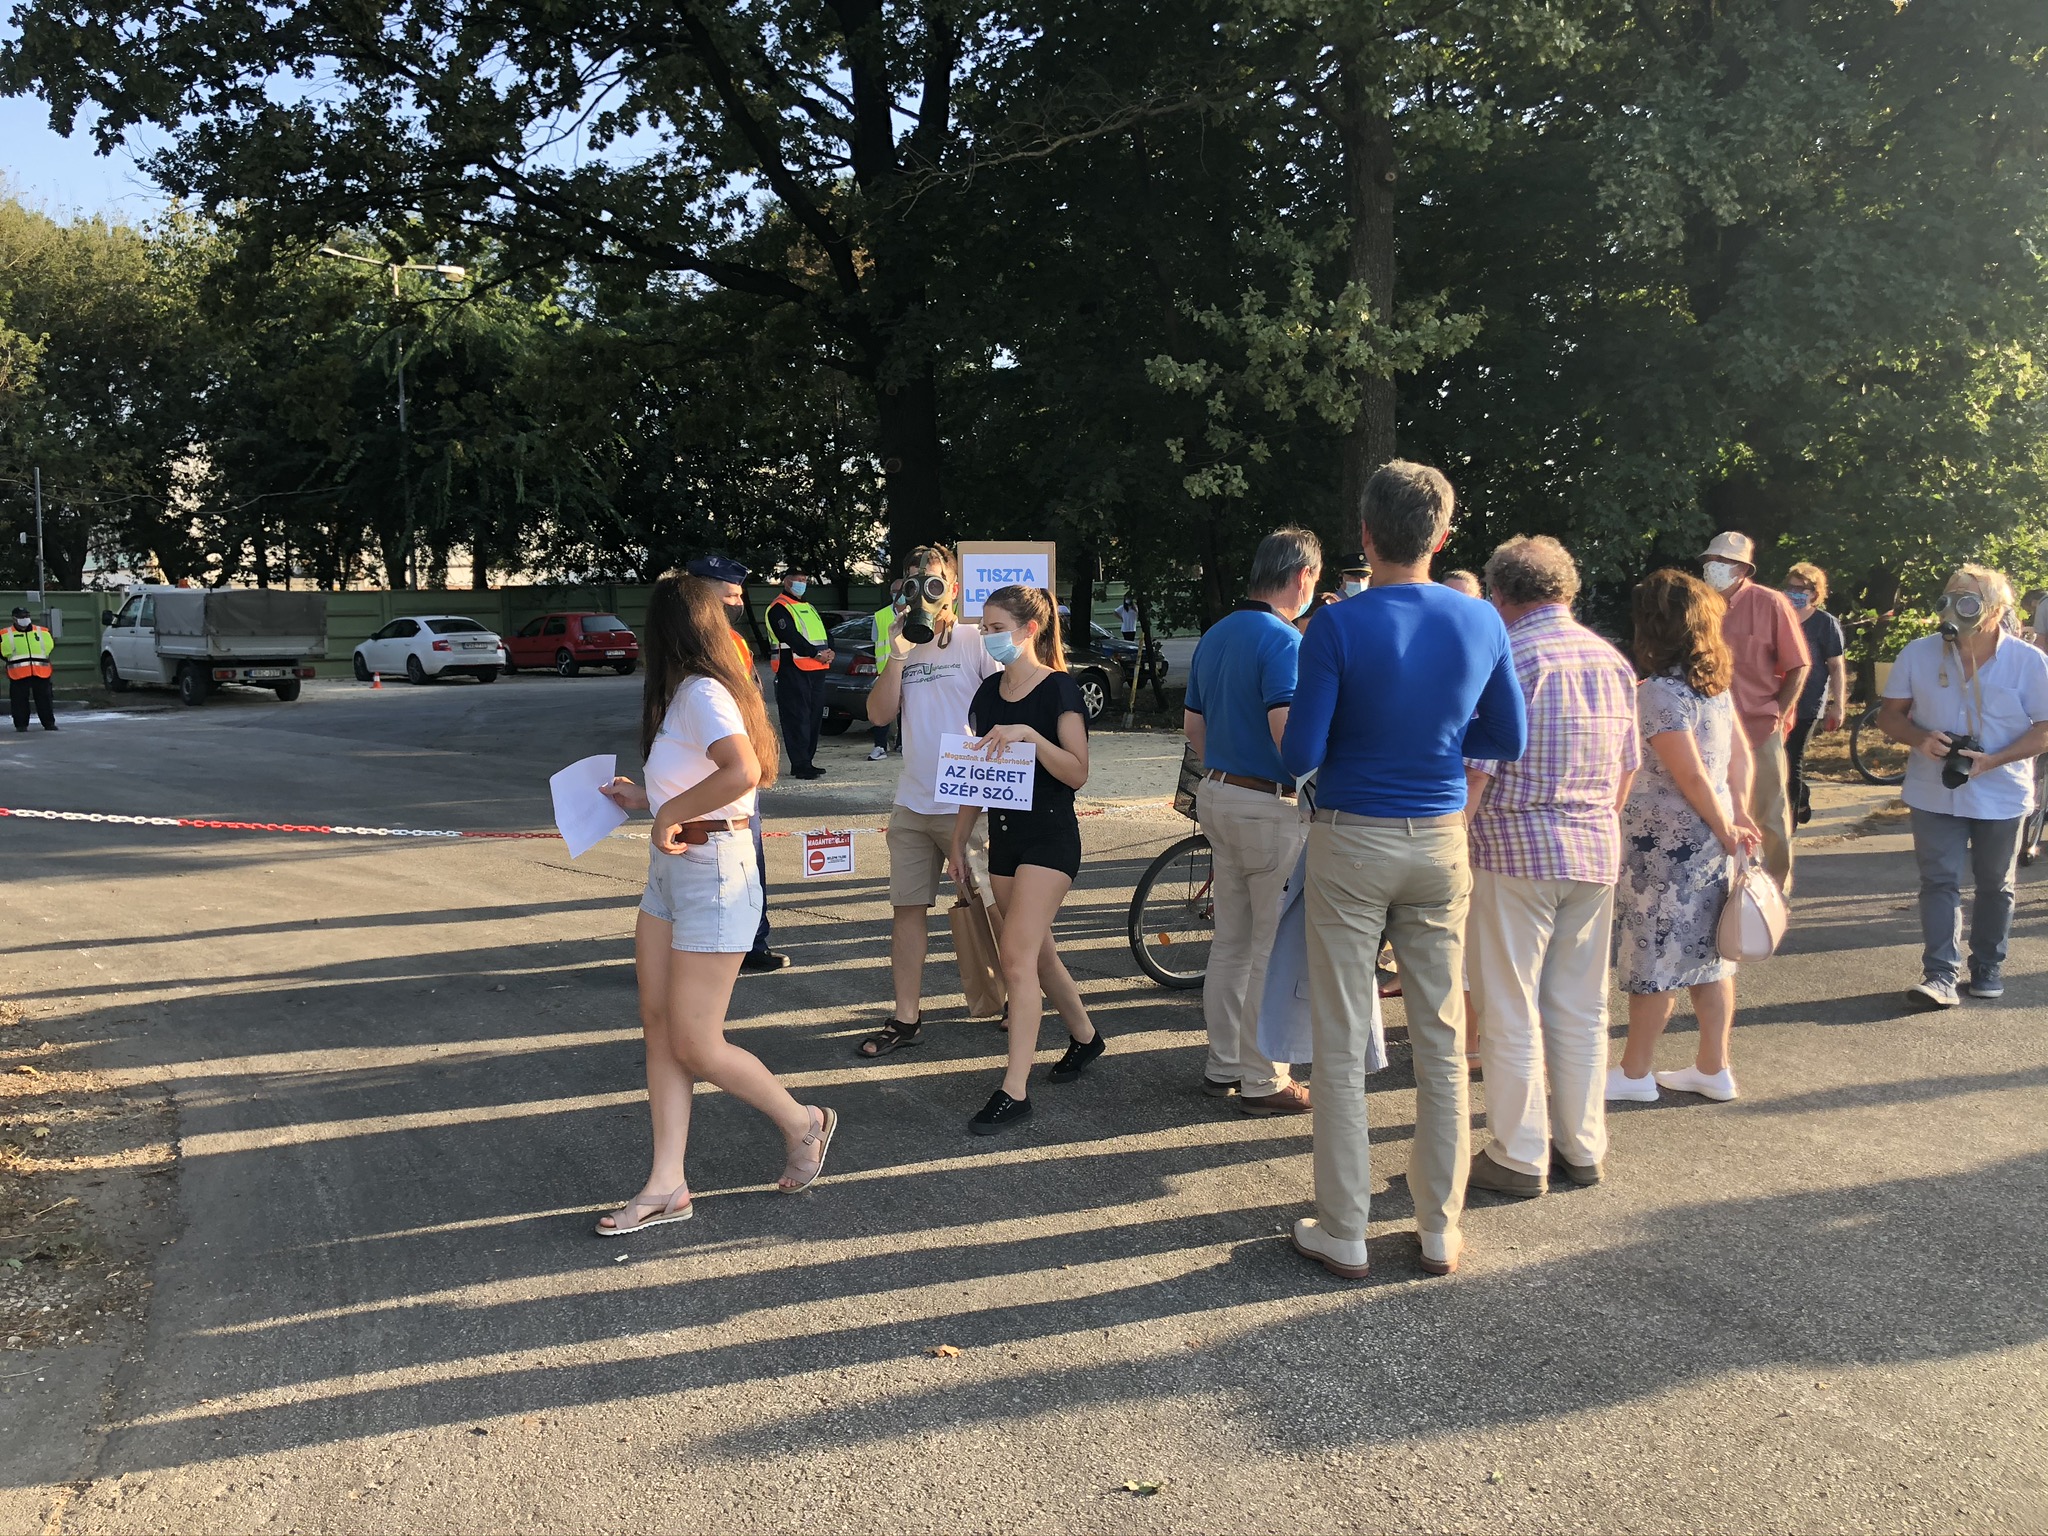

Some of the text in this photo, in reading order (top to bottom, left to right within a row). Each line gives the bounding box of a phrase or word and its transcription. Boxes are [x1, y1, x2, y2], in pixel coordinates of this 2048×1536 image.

[976, 568, 1035, 582] TISZTA
[945, 765, 1027, 784] AZ ÍGÉRET
[939, 782, 979, 798] SZÉP
